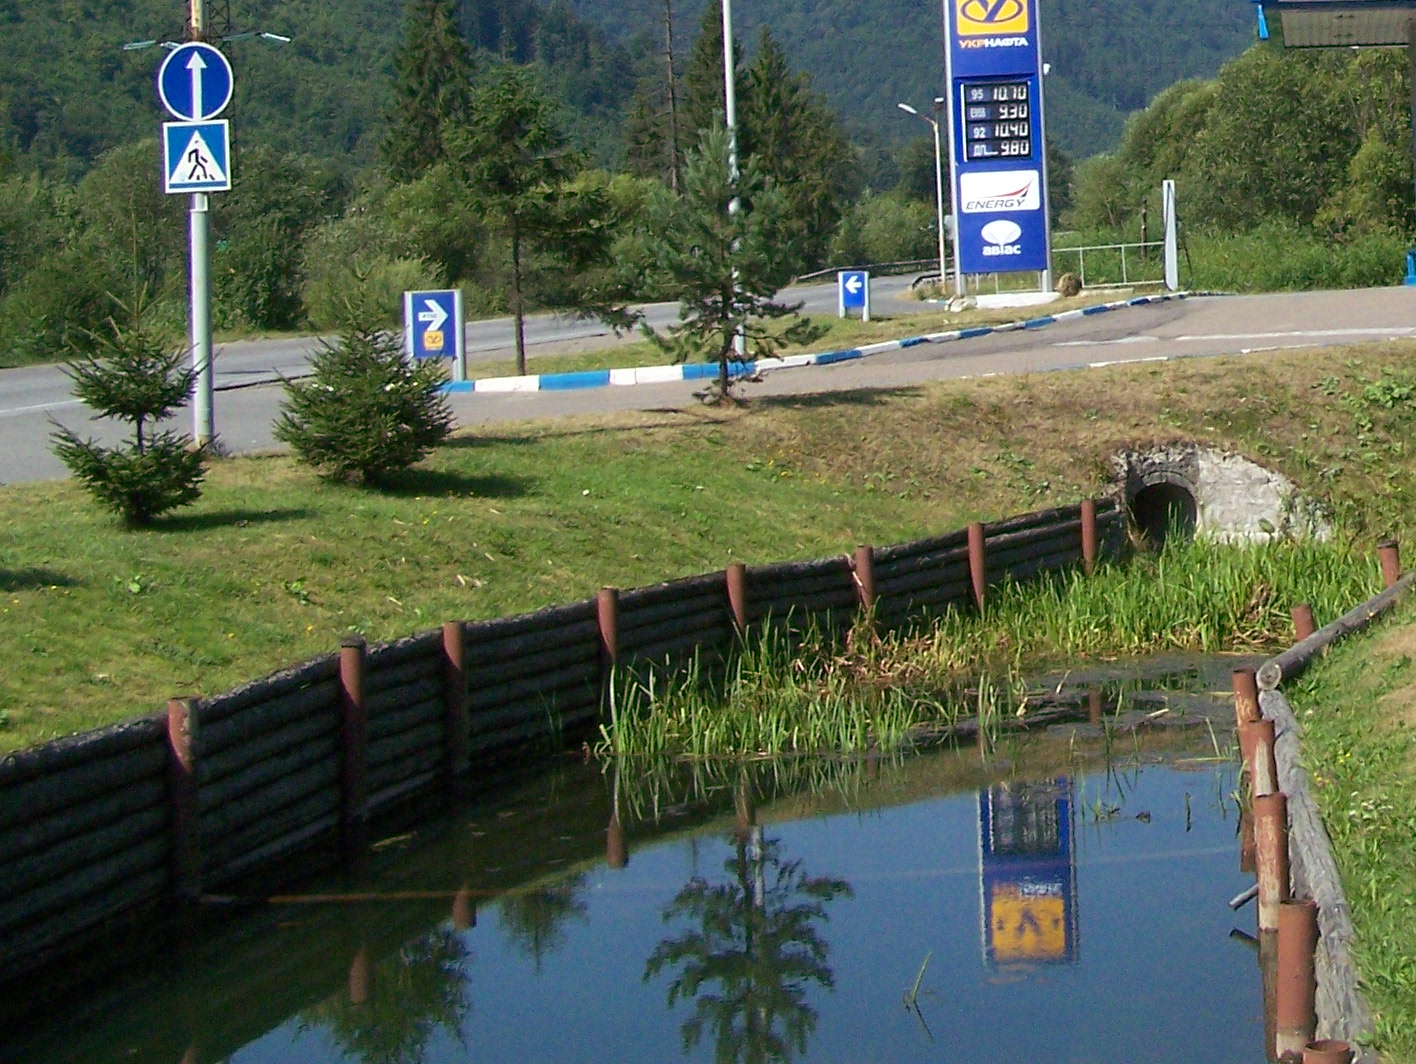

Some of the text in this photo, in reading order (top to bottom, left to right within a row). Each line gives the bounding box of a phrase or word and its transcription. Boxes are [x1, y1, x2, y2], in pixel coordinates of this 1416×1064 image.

[959, 37, 1028, 48] УКРНАФТА
[971, 85, 1026, 101] 95 10.70
[999, 103, 1027, 119] 9.30
[973, 122, 1028, 139] 92 10.40
[965, 199, 1025, 210] ENERGY
